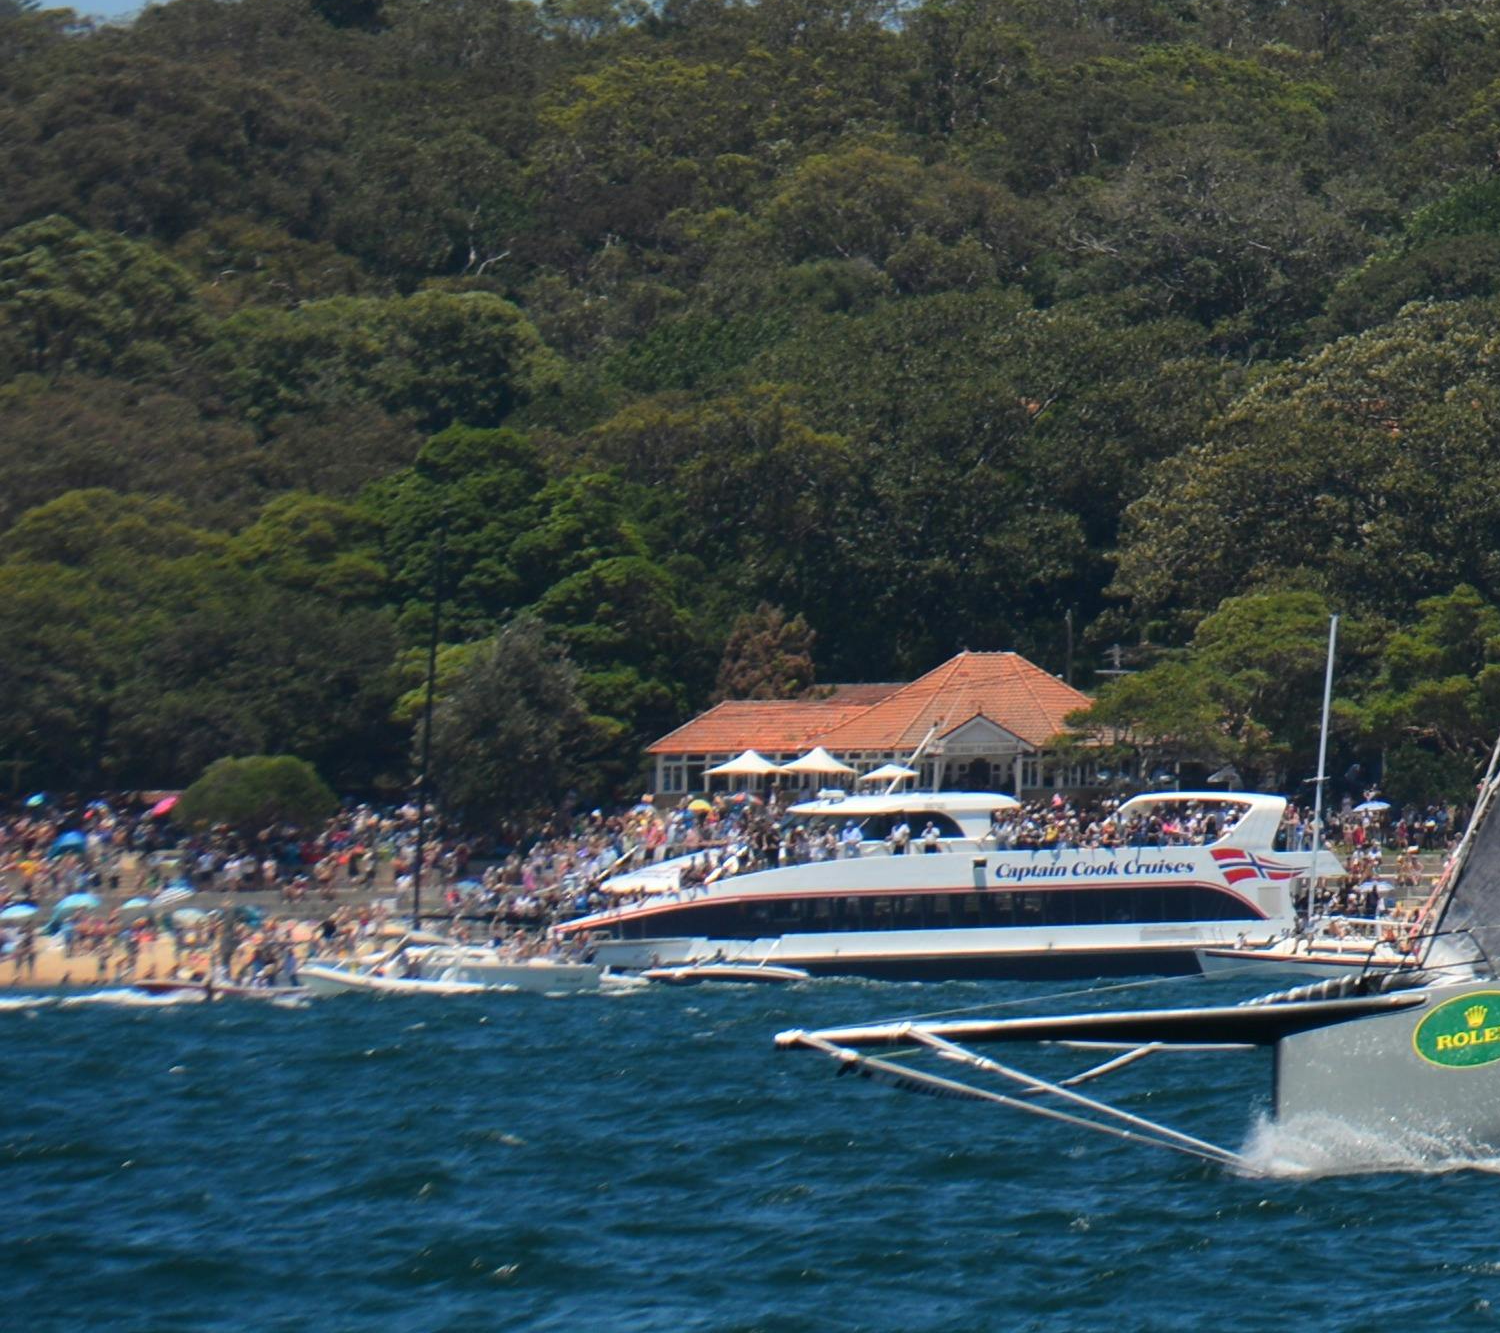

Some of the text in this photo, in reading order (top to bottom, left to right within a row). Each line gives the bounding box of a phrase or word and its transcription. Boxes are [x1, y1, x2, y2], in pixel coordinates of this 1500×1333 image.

[995, 858, 1196, 881] Captain Cook Cruises
